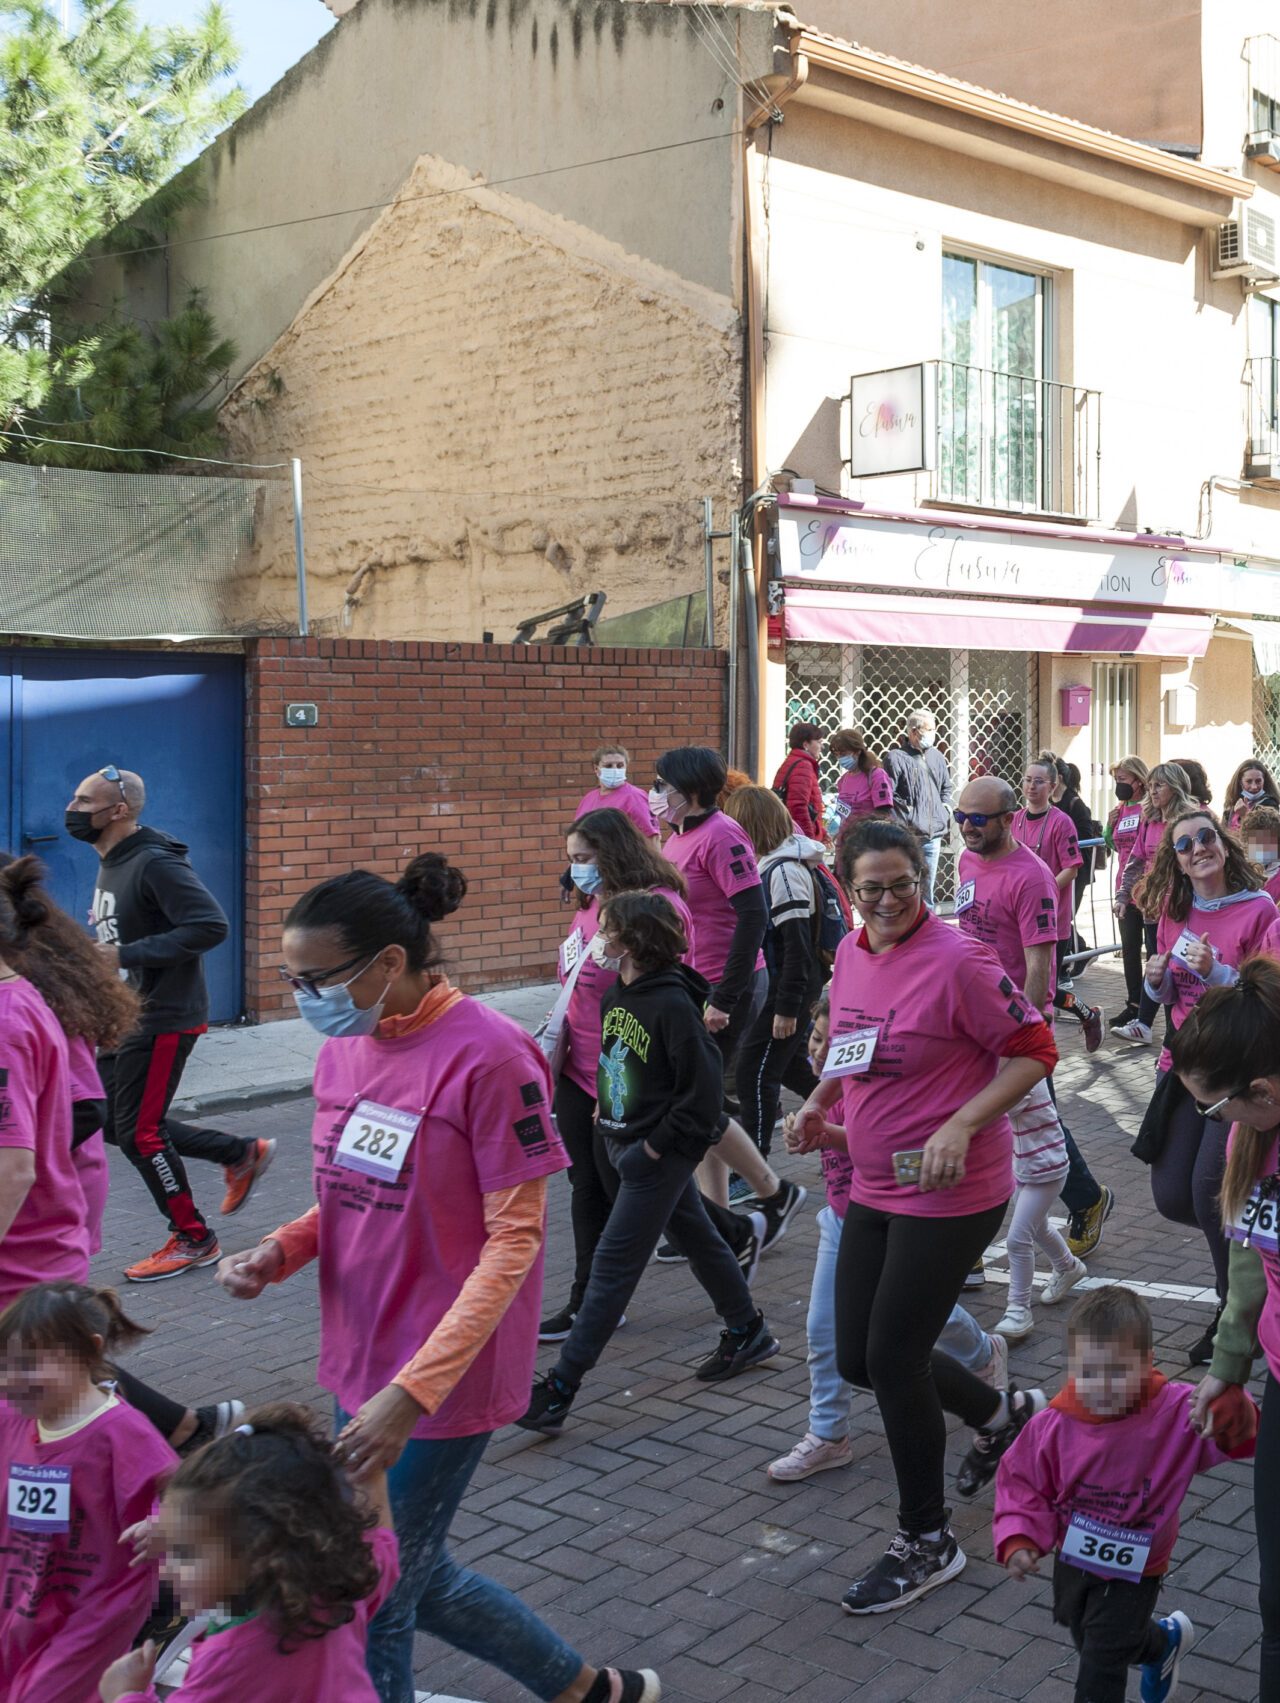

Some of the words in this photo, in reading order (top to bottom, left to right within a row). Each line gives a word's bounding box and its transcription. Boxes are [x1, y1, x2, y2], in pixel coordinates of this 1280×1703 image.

[295, 709, 306, 720] 4
[838, 804, 849, 815] 290
[1123, 819, 1135, 828] 133
[834, 1043, 867, 1066] 259
[353, 1125, 399, 1160] 282
[17, 1485, 57, 1515] 292
[1079, 1536, 1134, 1566] 366
